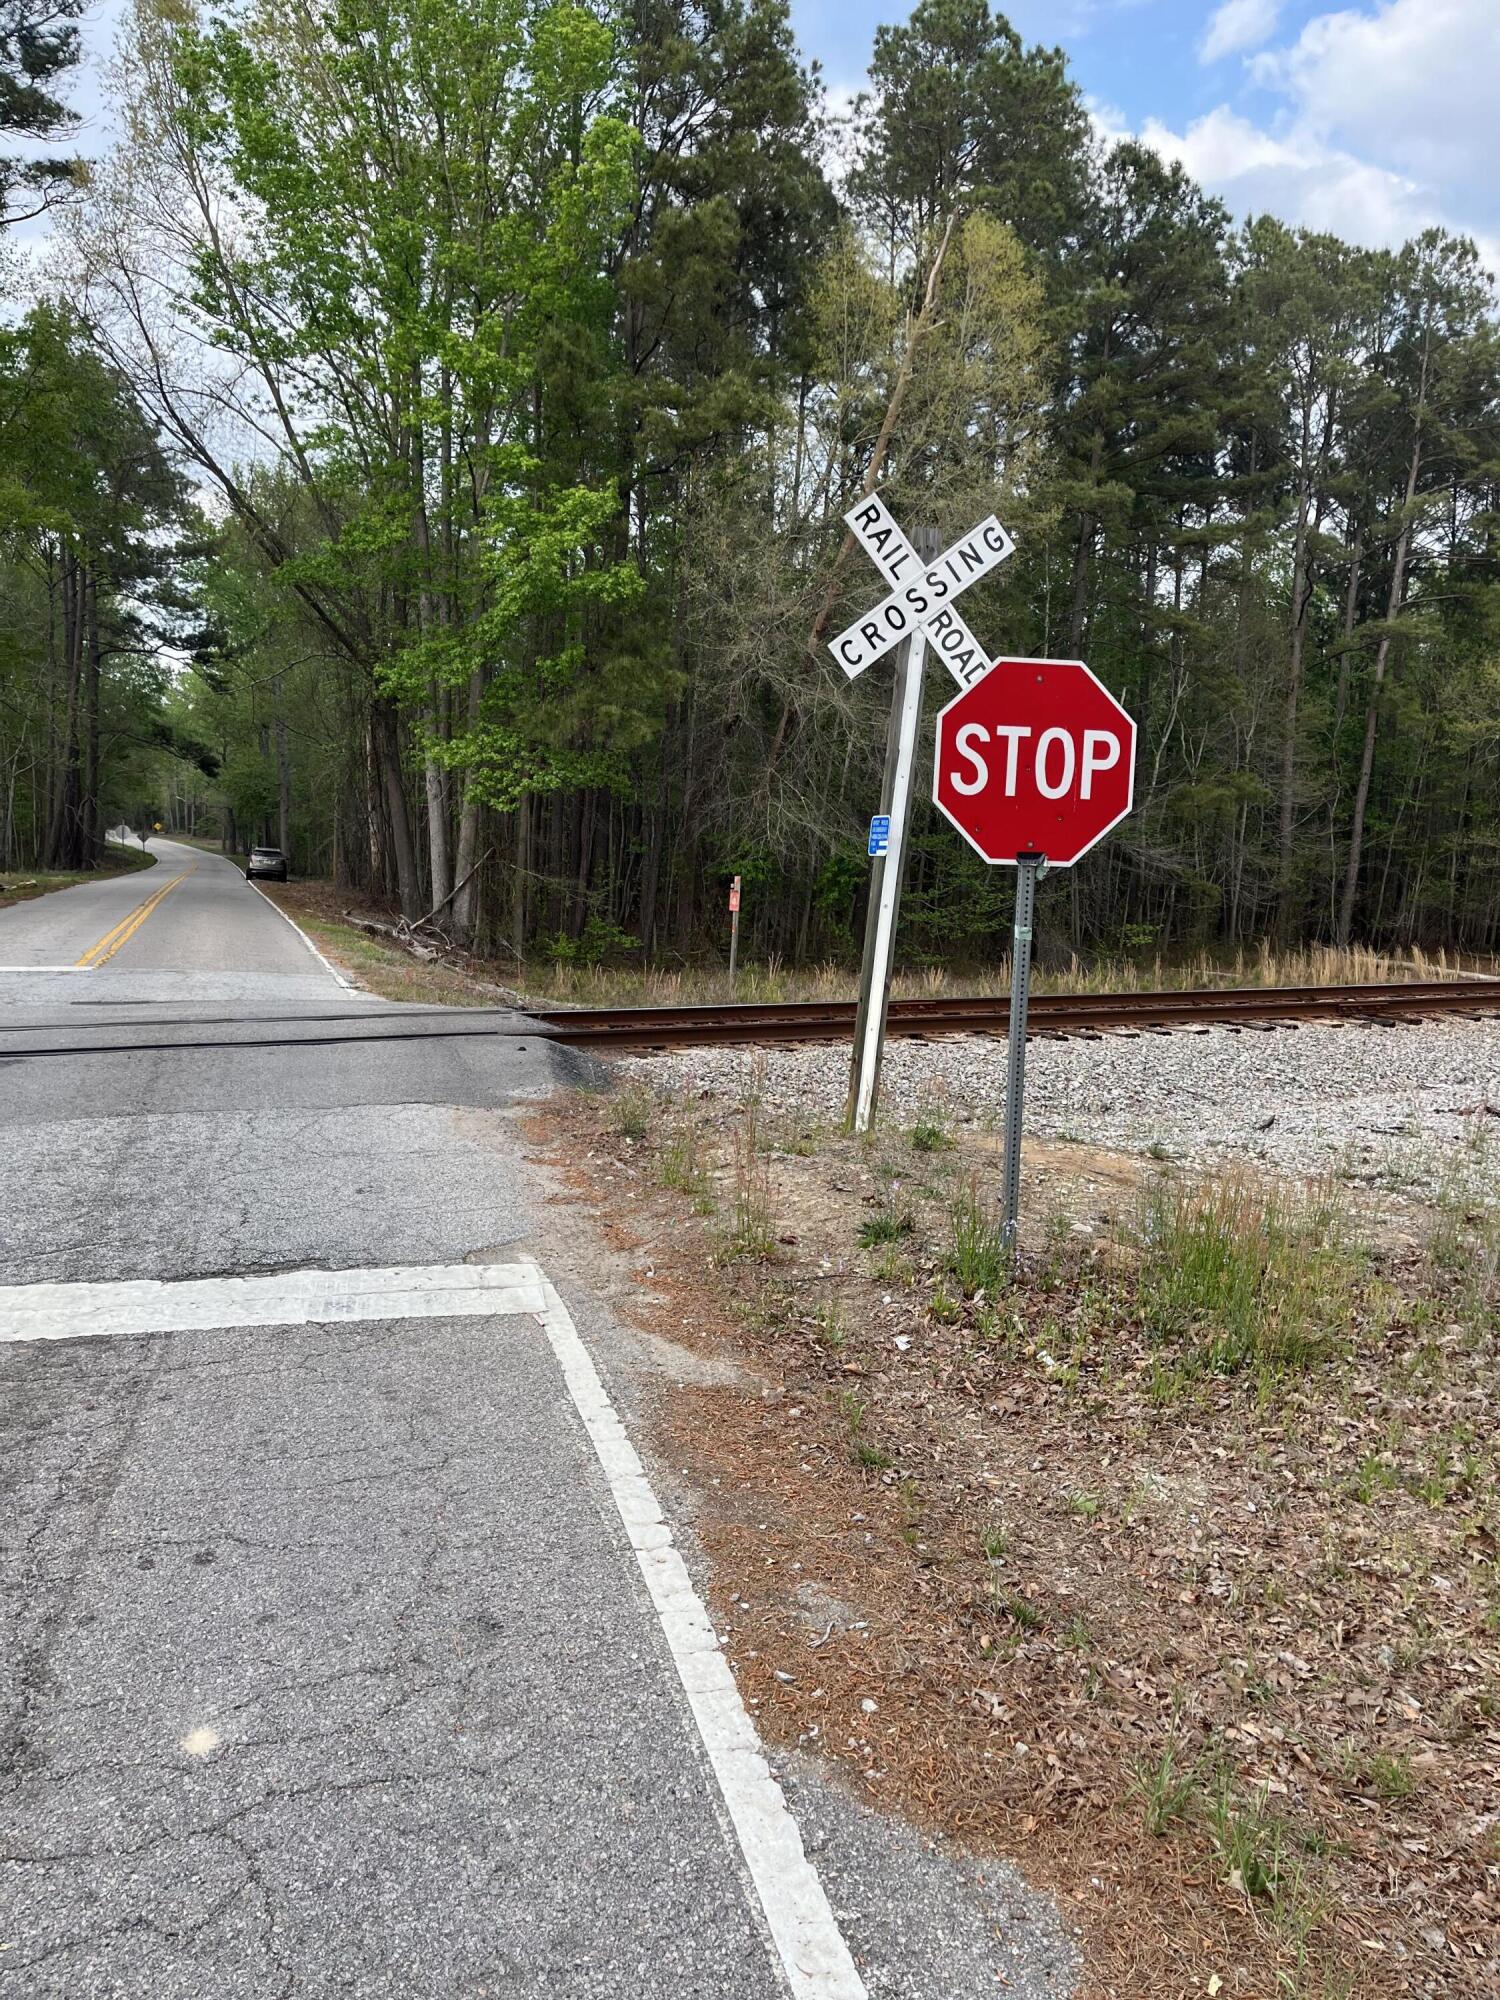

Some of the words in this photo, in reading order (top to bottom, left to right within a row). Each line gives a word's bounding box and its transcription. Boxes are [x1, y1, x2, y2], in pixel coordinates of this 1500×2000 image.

[855, 503, 910, 581] RAIL
[840, 526, 1005, 666] CROSSING
[950, 722, 1121, 801] STOP
